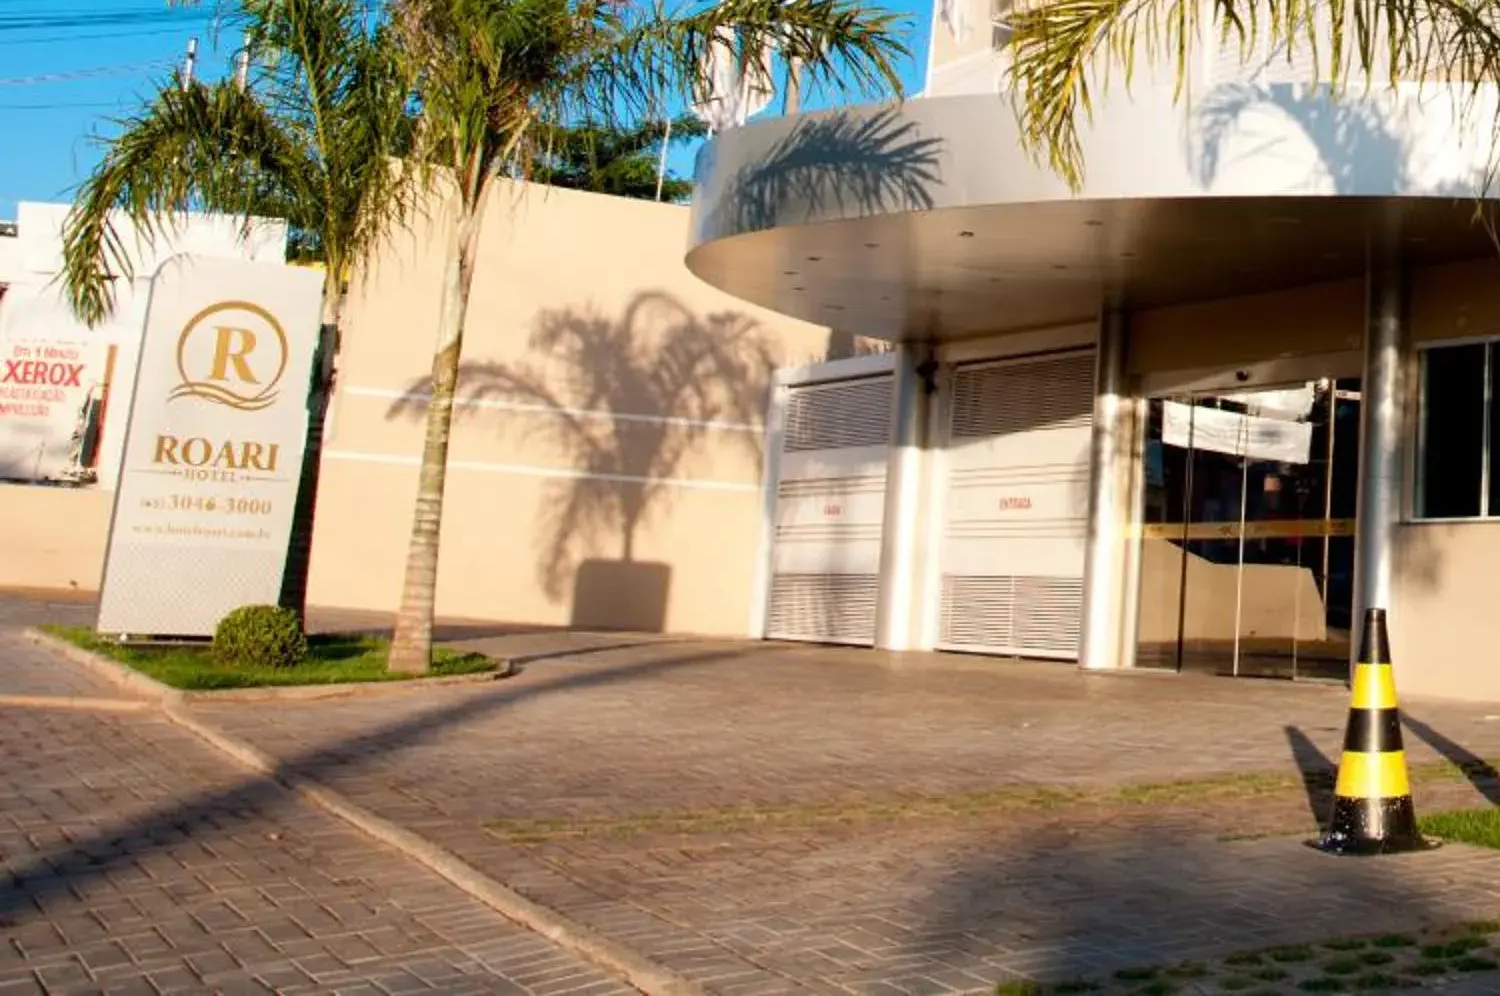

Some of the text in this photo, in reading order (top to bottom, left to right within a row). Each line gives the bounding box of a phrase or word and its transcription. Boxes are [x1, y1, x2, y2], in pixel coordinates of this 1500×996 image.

[208, 325, 259, 385] R
[2, 359, 85, 388] XEROX
[153, 434, 280, 472] ROARI
[184, 468, 238, 483] HOTEL
